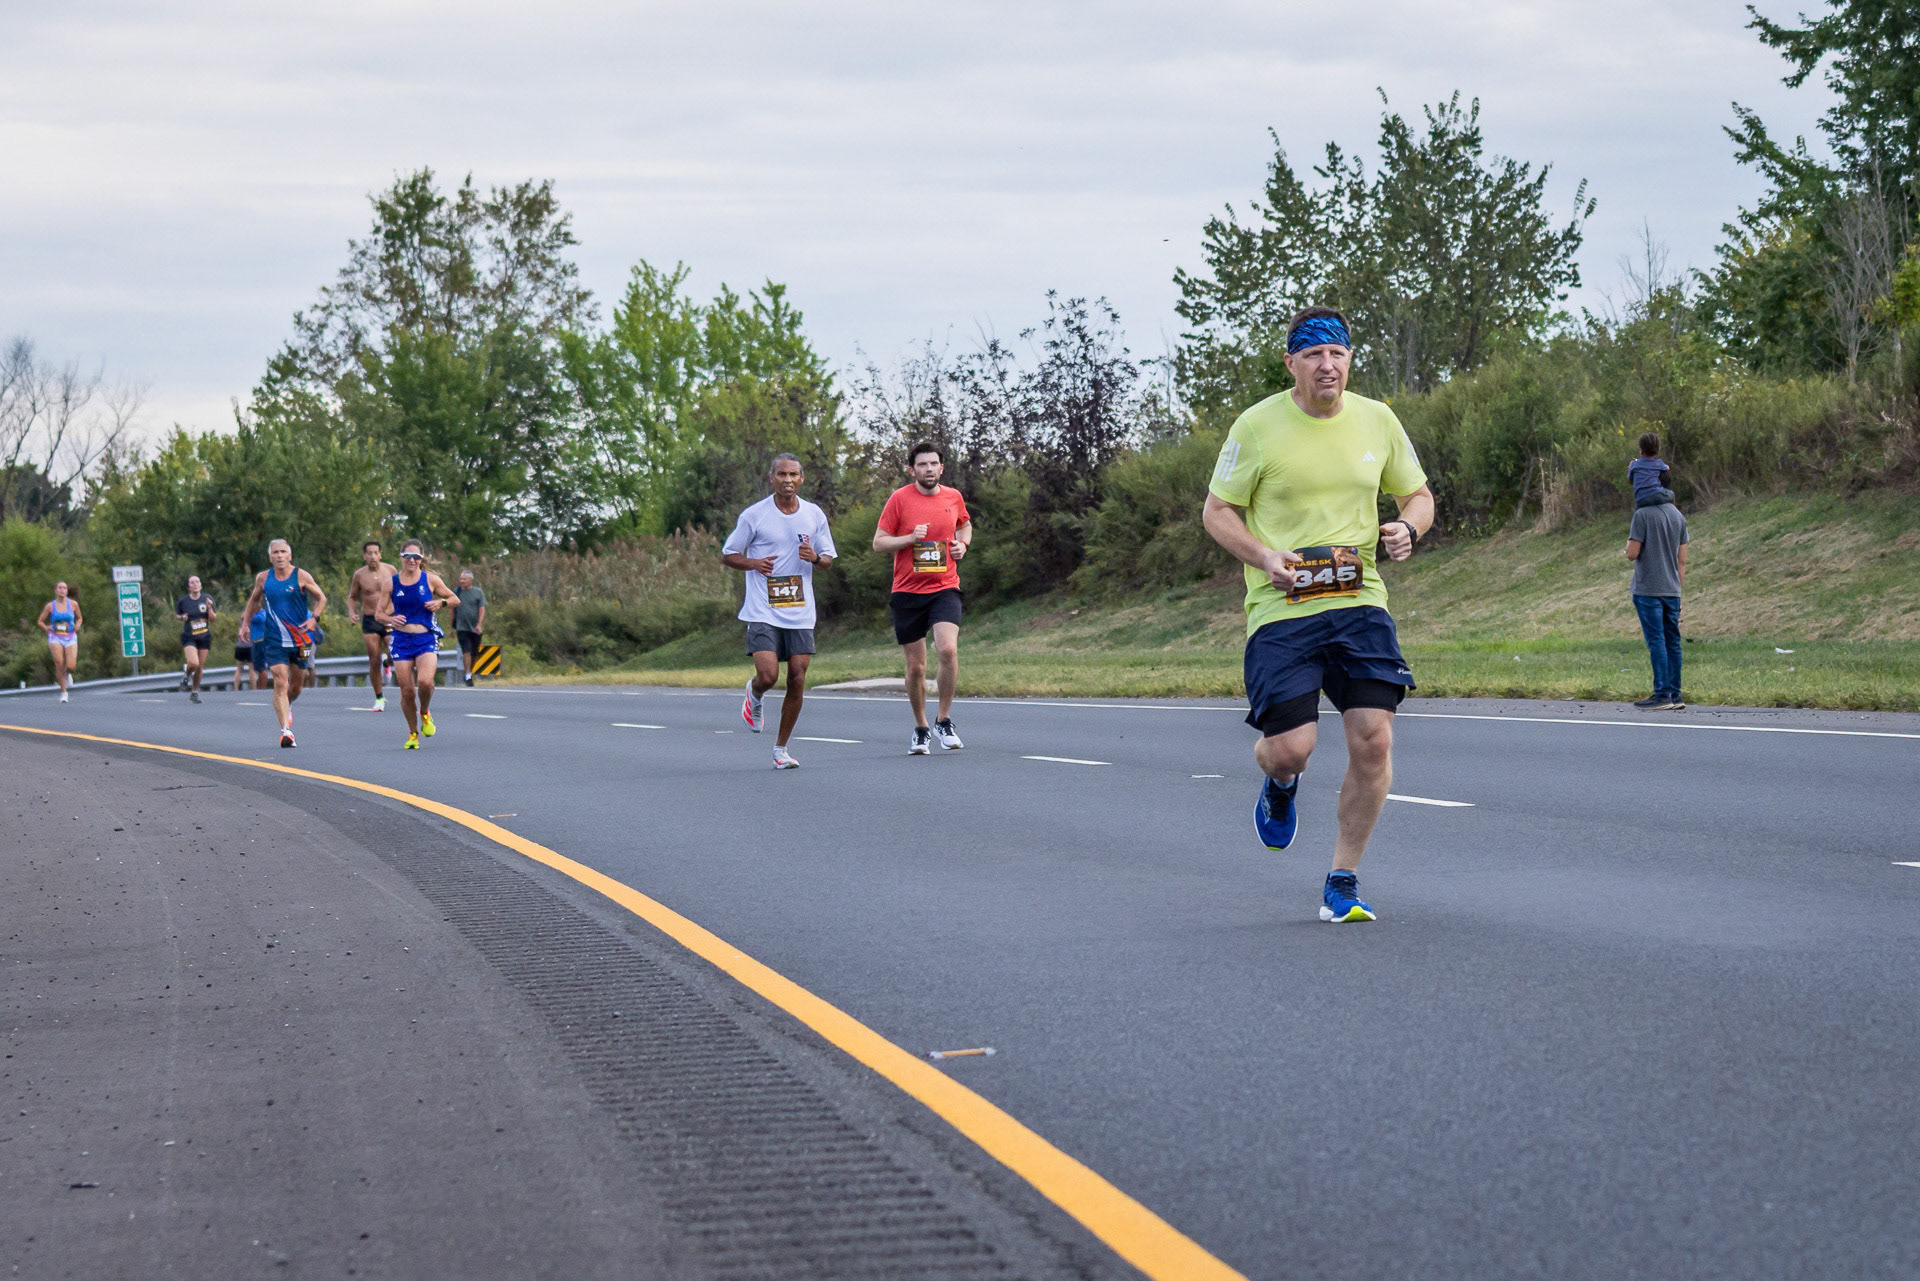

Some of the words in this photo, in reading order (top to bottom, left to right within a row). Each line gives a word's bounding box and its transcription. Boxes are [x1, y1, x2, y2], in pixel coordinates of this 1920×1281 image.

[920, 551, 940, 560] 48
[1294, 566, 1356, 587] 345
[773, 586, 798, 596] 147
[123, 601, 139, 611] 206
[123, 617, 140, 626] MILE
[130, 627, 136, 639] 2
